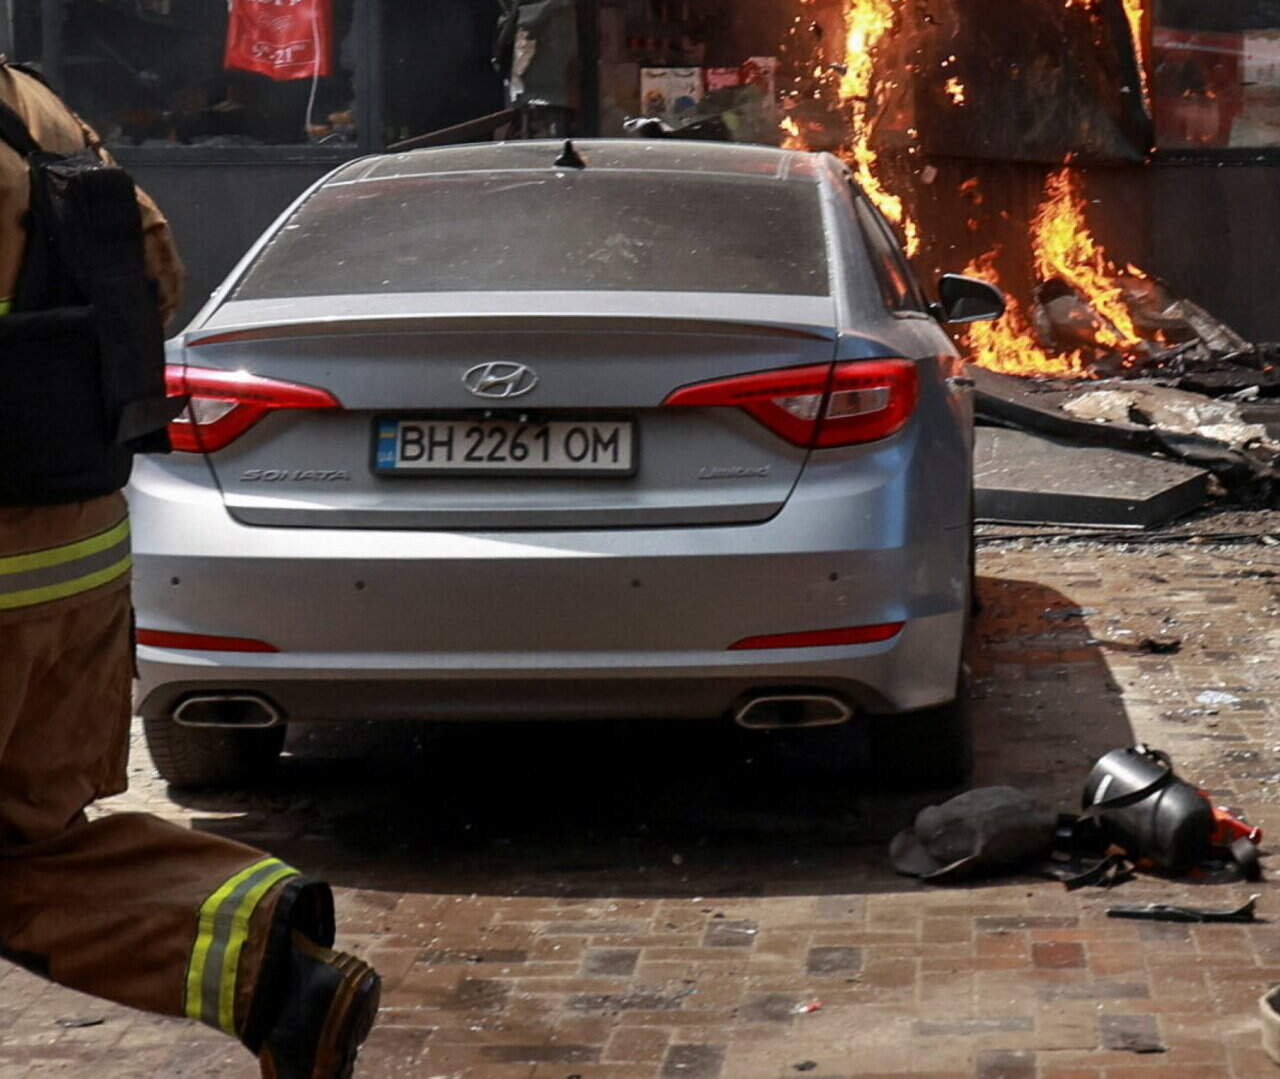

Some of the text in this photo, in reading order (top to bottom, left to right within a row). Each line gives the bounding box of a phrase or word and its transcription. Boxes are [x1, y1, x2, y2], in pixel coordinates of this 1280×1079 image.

[400, 425, 621, 463] BH 2261 OM
[239, 468, 352, 482] SONATA
